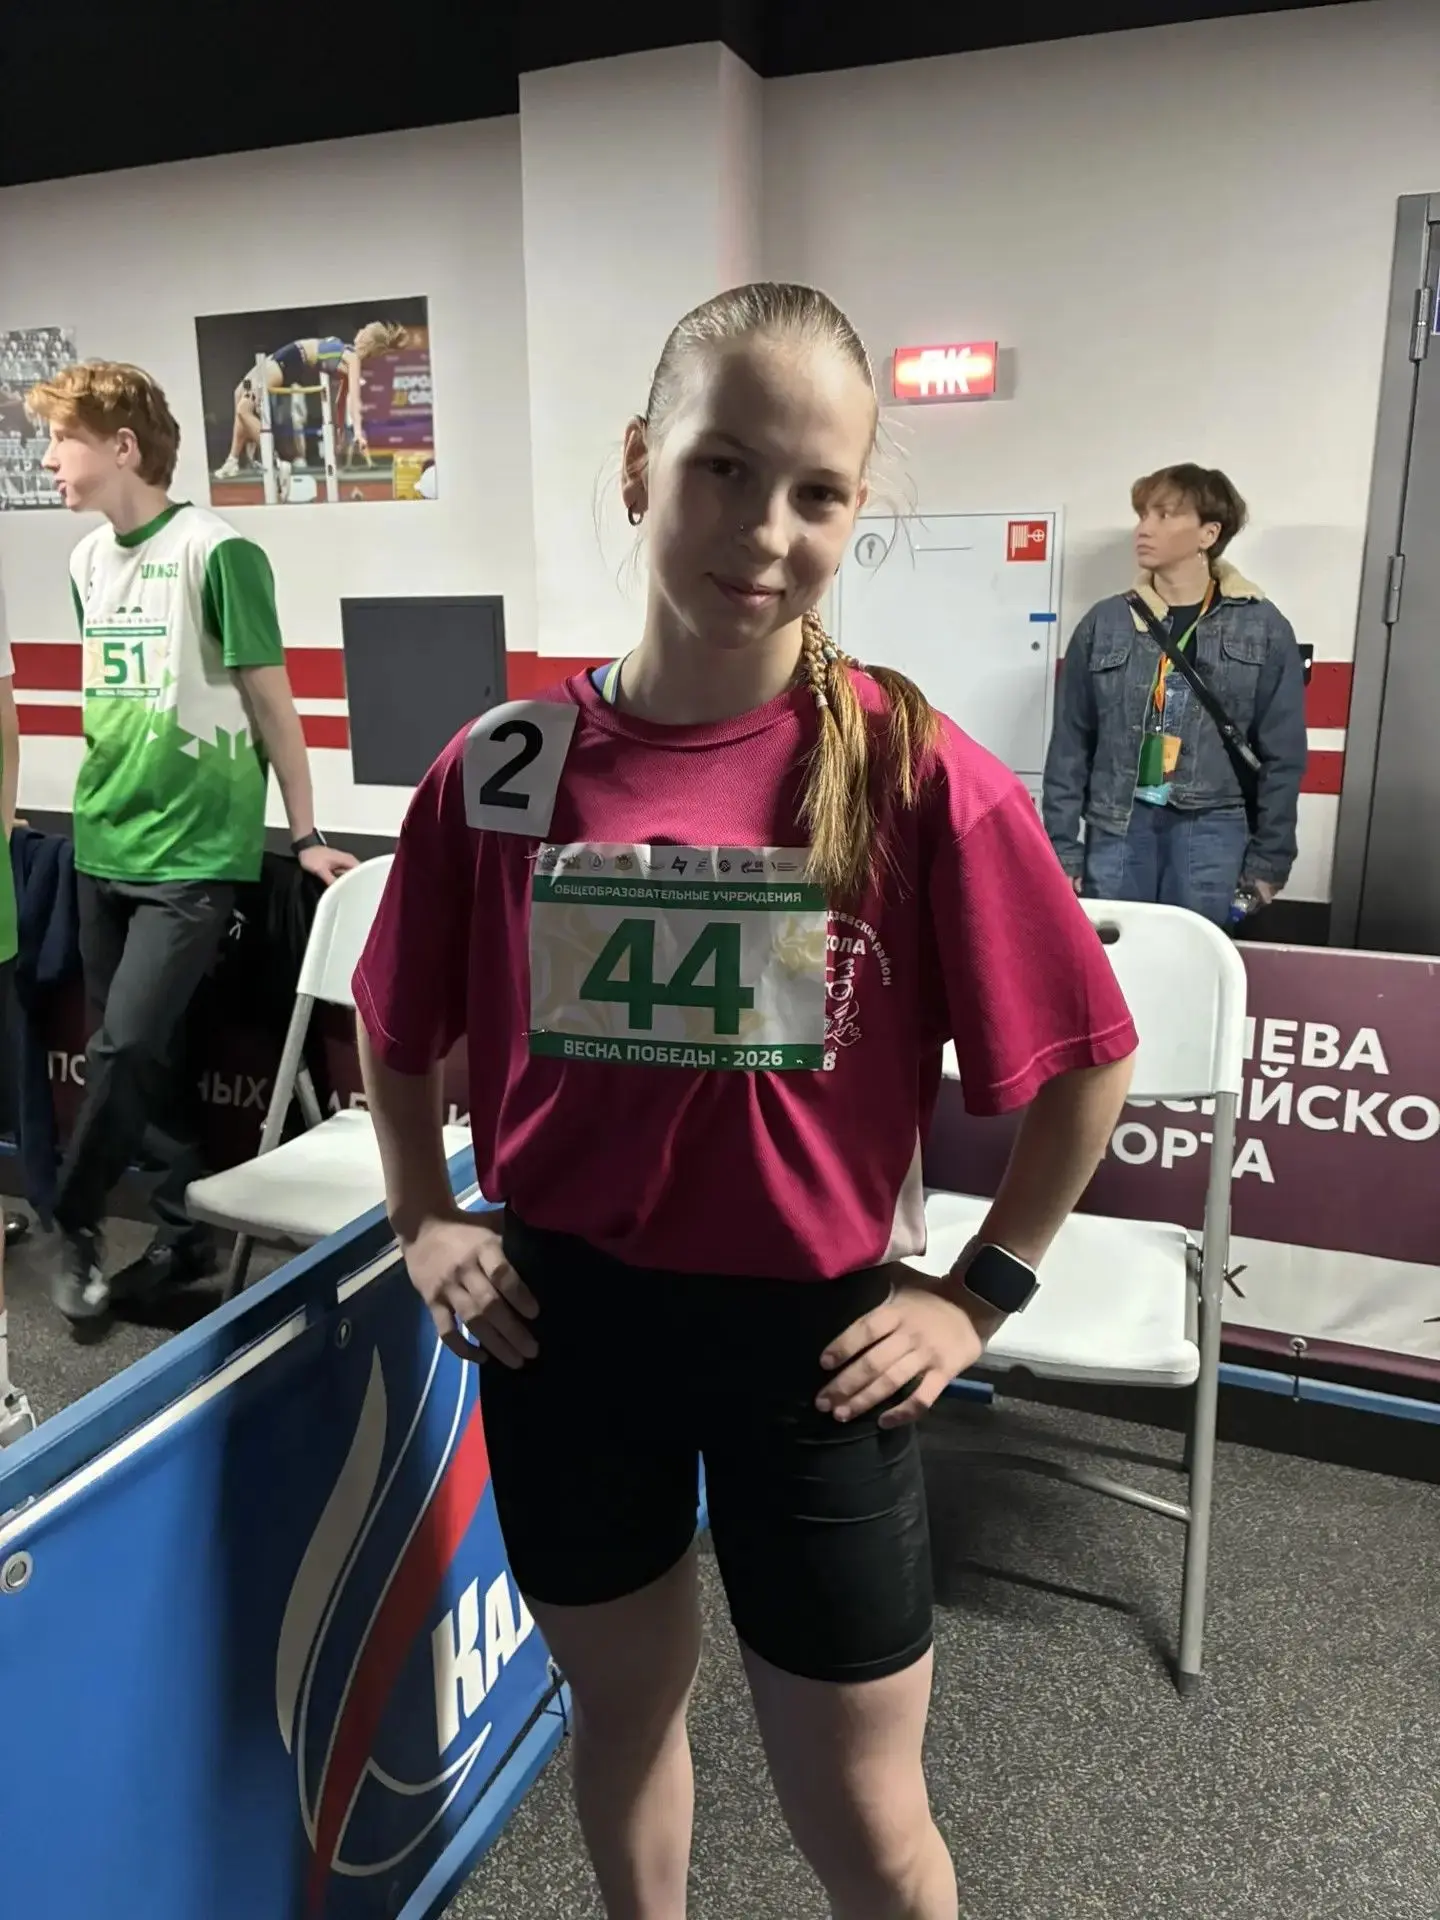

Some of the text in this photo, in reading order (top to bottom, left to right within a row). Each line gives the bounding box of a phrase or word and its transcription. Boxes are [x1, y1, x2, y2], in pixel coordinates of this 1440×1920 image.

[103, 641, 146, 685] 51
[480, 720, 543, 810] 2
[554, 883, 802, 905] ОБЩЕОБРАЗОВАТЕЛЬНЫЕ УЧРЕЖДЕНИЯ
[579, 918, 755, 1035] 44
[872, 941, 892, 987] район
[563, 1039, 622, 1059] ВЕСНА
[627, 1045, 716, 1068] ПОБЕДЫ
[733, 1050, 783, 1067] 2026
[1125, 1064, 1440, 1141] ЙСКО
[1101, 1122, 1275, 1184] ОРА
